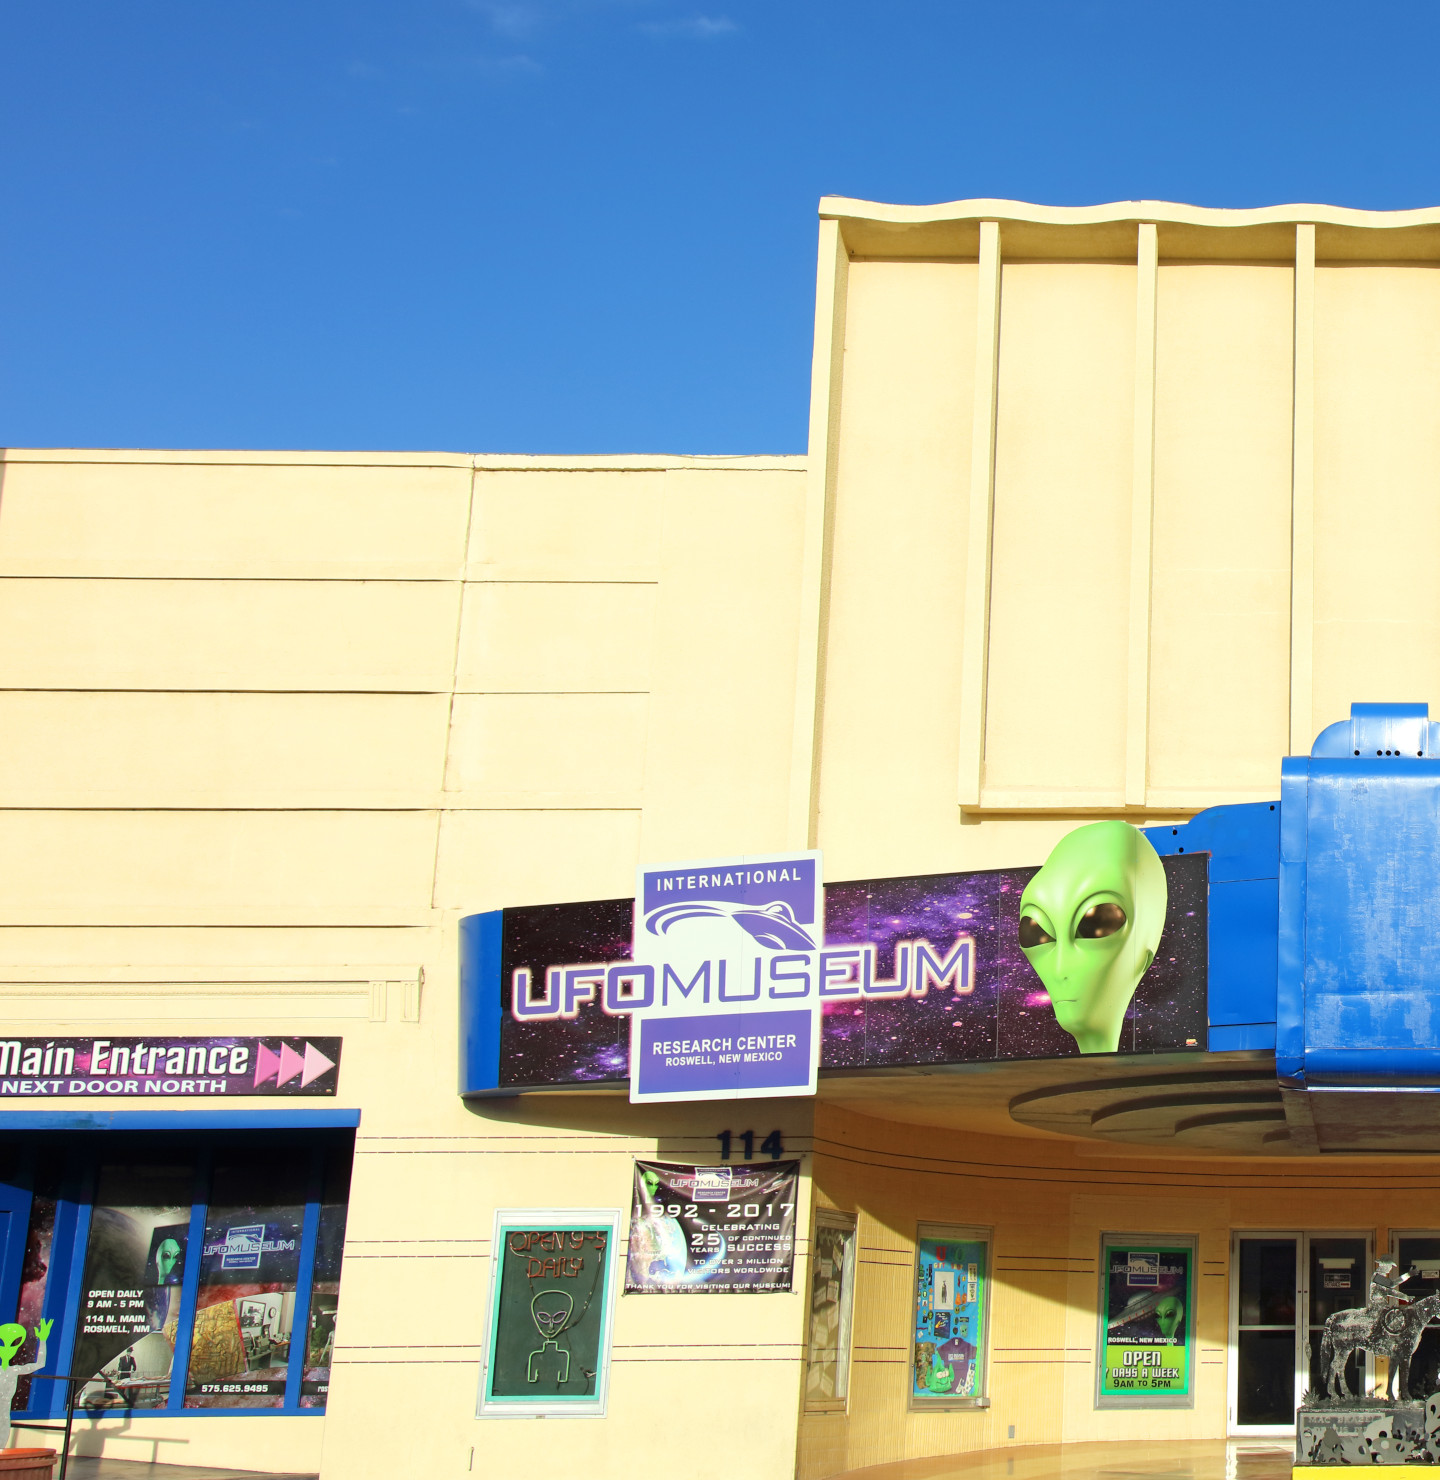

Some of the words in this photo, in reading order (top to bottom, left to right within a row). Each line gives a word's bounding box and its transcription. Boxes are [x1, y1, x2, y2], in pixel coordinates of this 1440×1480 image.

[657, 868, 801, 891] INTERNATIONAL
[653, 1038, 732, 1055] RESEARCH
[737, 1034, 797, 1050] CENTER
[0, 1041, 74, 1075] Main
[90, 1041, 249, 1075] Entrance
[665, 1055, 715, 1067] ROSWELL,
[719, 1053, 742, 1063] NEW
[744, 1051, 783, 1062] MEXICO
[1, 1080, 64, 1093] NEXT
[69, 1080, 139, 1093] DOOR
[144, 1080, 227, 1093] NORTH
[717, 1130, 784, 1160] 114
[636, 1204, 698, 1218] 1992
[727, 1204, 795, 1217] 2017
[510, 1231, 565, 1250] OPEN
[691, 1234, 720, 1246] 25
[528, 1257, 583, 1277] DAILY
[88, 1290, 114, 1298] OPEN
[117, 1290, 143, 1298] DAILY
[87, 1300, 94, 1308] 9
[96, 1300, 112, 1308] AM
[120, 1300, 127, 1308] 5
[129, 1300, 144, 1308] PM
[86, 1315, 104, 1323] 114
[106, 1315, 116, 1323] N.
[120, 1315, 145, 1323] MAIN
[83, 1325, 130, 1334] ROSWELL,
[133, 1325, 150, 1333] NM
[1123, 1351, 1161, 1366] OPEN
[1112, 1368, 1138, 1378] DAYS
[1141, 1368, 1148, 1378] A
[1151, 1368, 1179, 1378] WEEK
[201, 1384, 268, 1393] 575.625.9495
[1113, 1379, 1134, 1387] 9AM
[1151, 1379, 1171, 1387] 5PM
